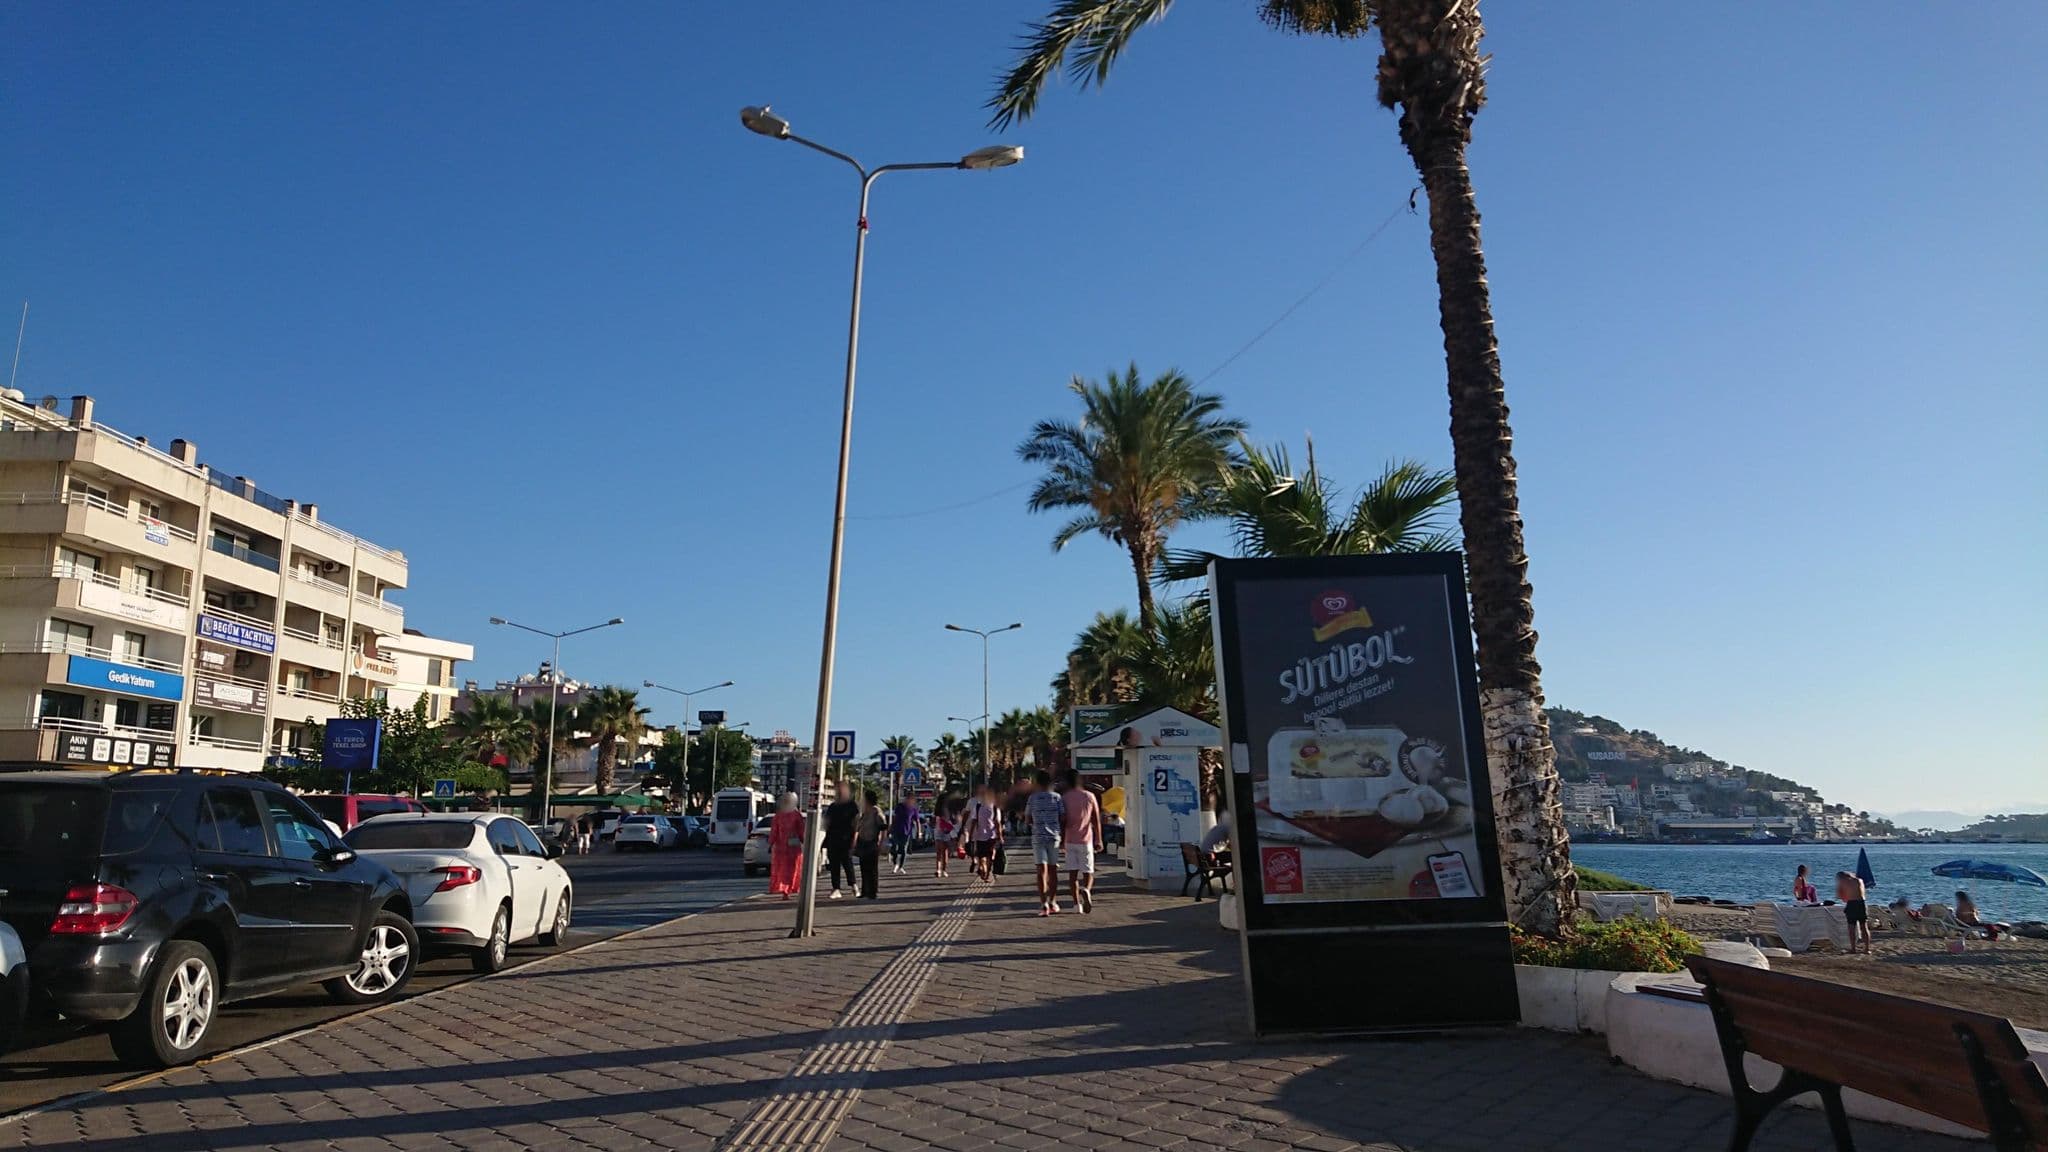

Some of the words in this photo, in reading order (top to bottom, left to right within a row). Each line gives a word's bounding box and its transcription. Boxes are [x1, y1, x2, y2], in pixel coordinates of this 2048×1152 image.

[213, 620, 239, 637] BEGÜM
[240, 627, 274, 645] YACHTING
[108, 670, 131, 685] Gedik
[1346, 674, 1379, 694] destan
[1085, 724, 1102, 734] 24
[69, 735, 88, 746] AKIN
[834, 736, 848, 754] D
[155, 744, 170, 754] AKIN
[885, 753, 898, 769] P
[1156, 772, 1166, 789] 2
